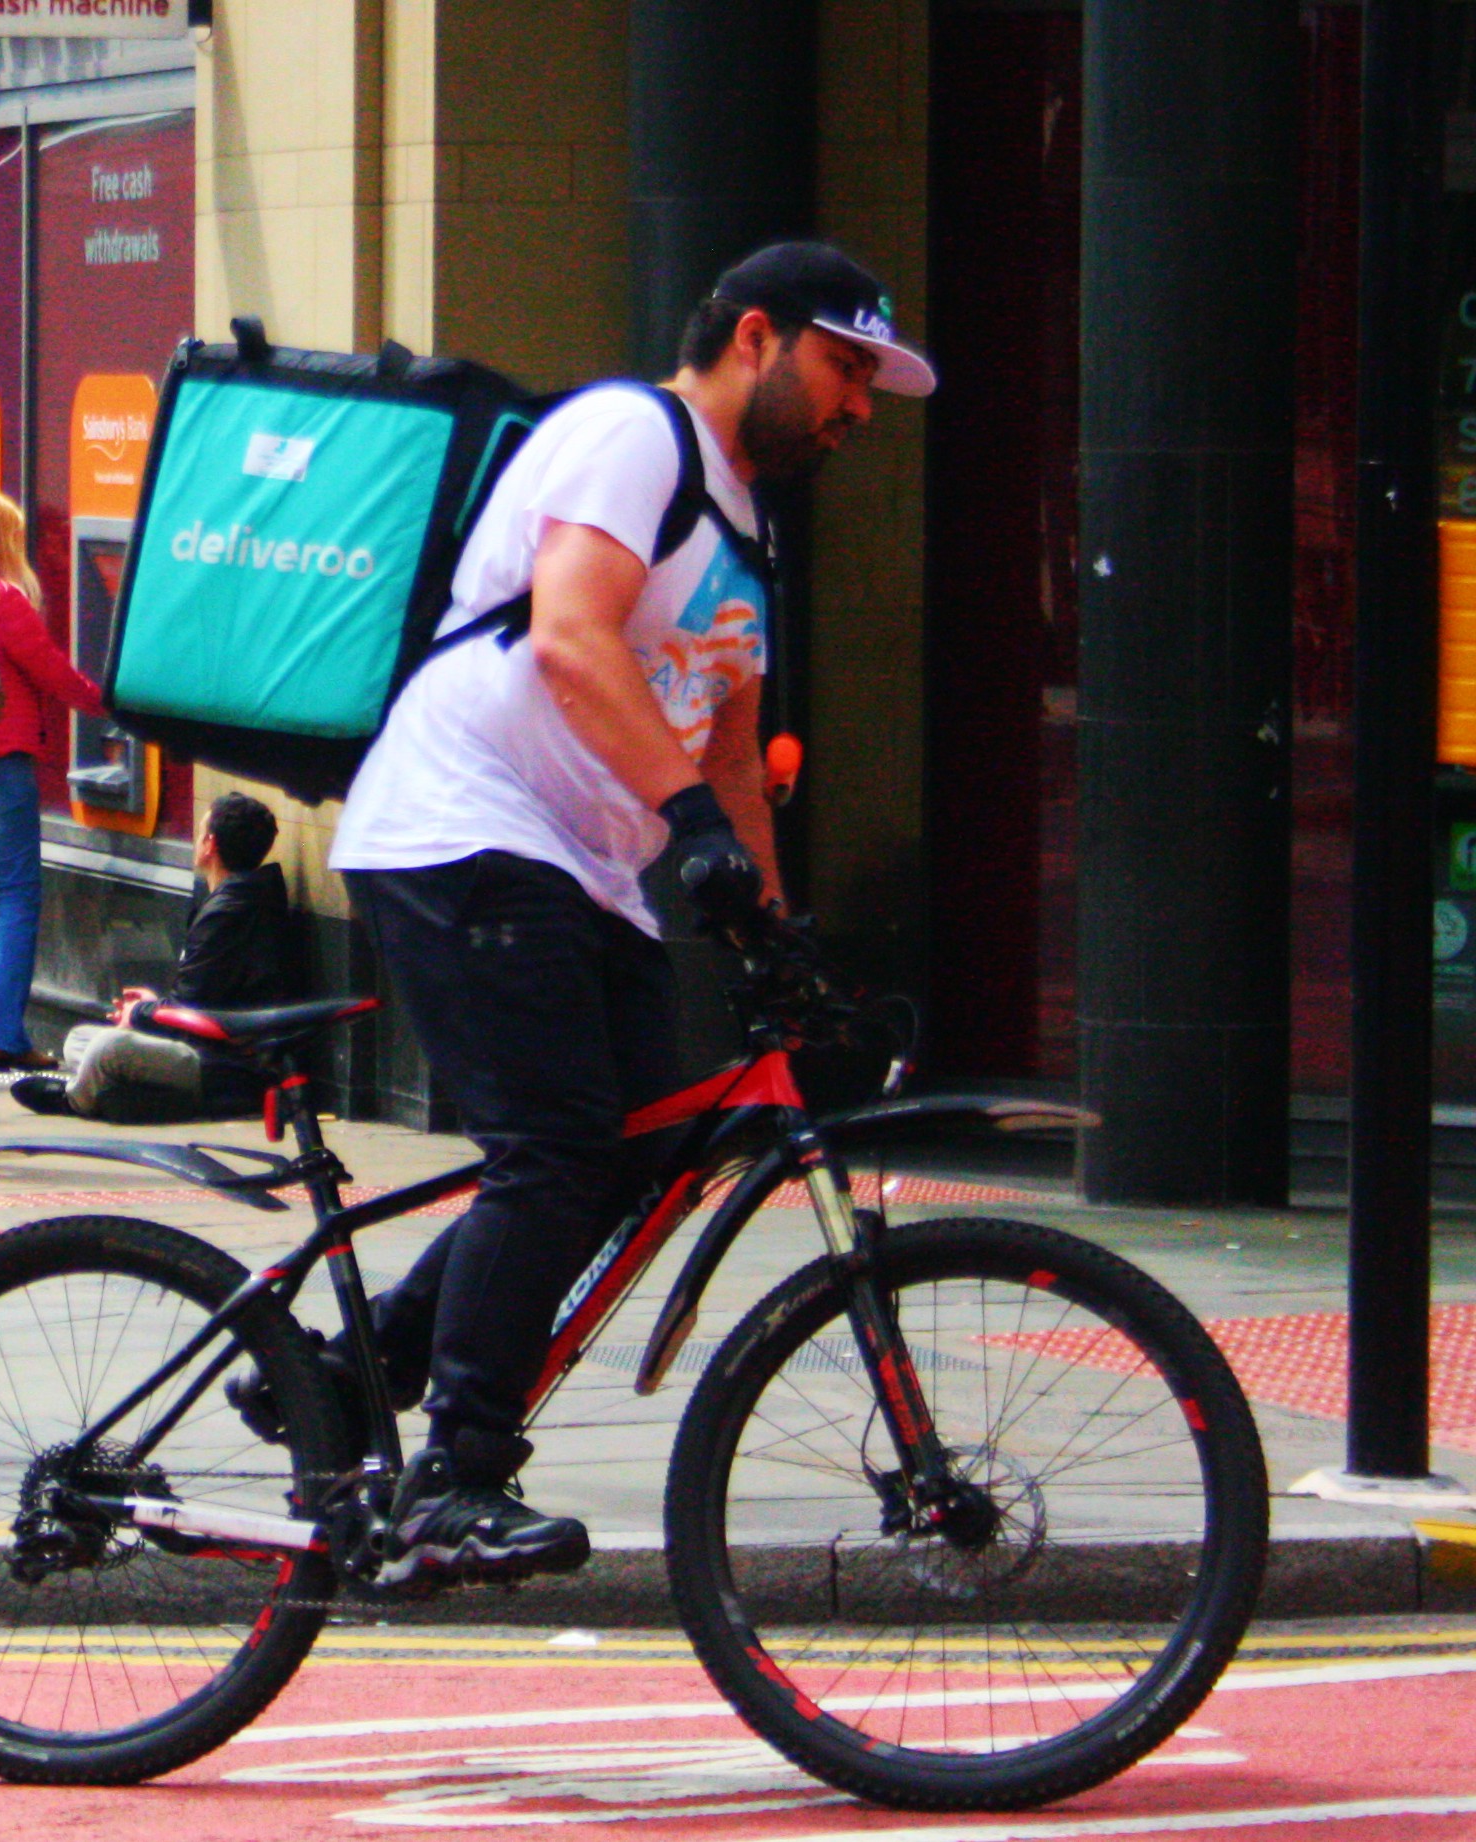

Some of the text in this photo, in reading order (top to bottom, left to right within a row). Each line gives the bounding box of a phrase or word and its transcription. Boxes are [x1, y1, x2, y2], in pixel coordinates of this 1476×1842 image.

[49, 0, 169, 17] machine
[91, 163, 152, 203] Free cash
[85, 227, 160, 266] withdrawals
[171, 520, 375, 580] deliveroo
